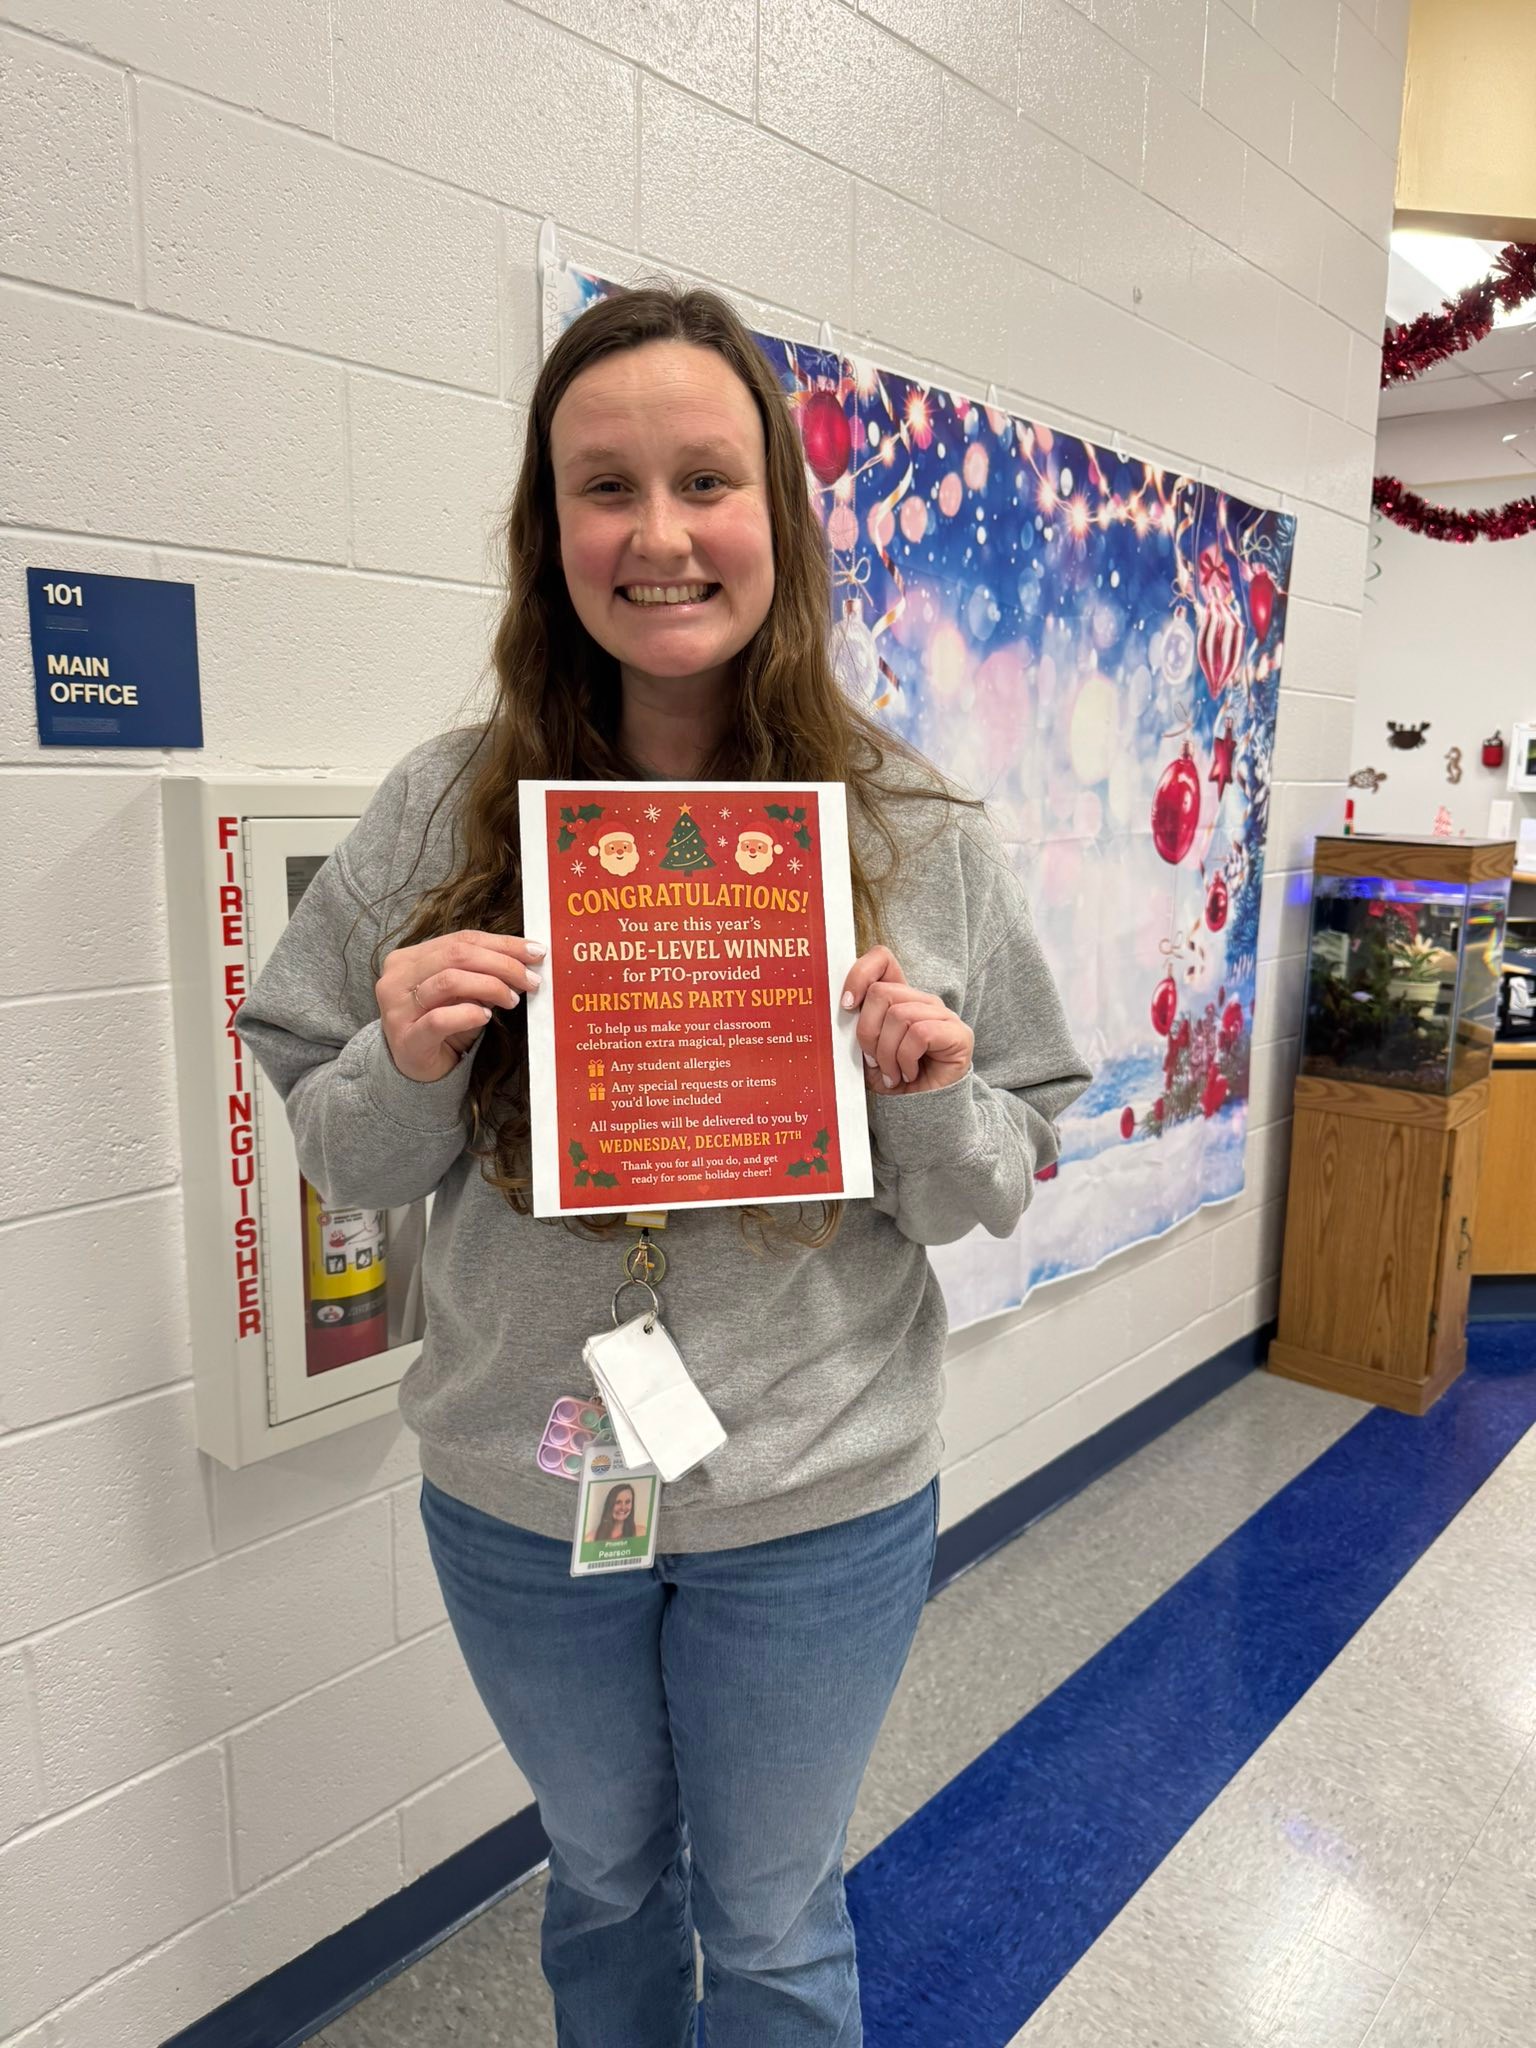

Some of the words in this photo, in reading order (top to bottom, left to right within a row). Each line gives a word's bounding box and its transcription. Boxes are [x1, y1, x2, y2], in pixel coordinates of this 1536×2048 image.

[43, 583, 83, 606] 101
[47, 654, 110, 677] MAIN
[49, 682, 139, 705] OFFICE
[218, 816, 244, 946] FIRE
[568, 883, 808, 915] CONGRATULATIONS!
[618, 918, 648, 932] You
[654, 921, 678, 932] are
[684, 917, 712, 931] this
[716, 917, 761, 934] year’s
[573, 940, 720, 961] GRADE-LEVEL
[724, 938, 810, 958] WINNER
[623, 968, 645, 982] for
[650, 966, 760, 984] PTO-provided
[572, 991, 683, 1012] CHRISTMAS
[688, 990, 746, 1009] PARTY
[752, 988, 812, 1006] SUPPL!
[587, 1024, 602, 1034] To
[605, 1023, 629, 1036] help
[634, 1024, 647, 1032] us
[651, 1022, 681, 1032] make
[685, 1023, 710, 1034] your
[714, 1019, 771, 1031] classroom
[576, 1039, 642, 1051] celebration
[645, 1039, 675, 1048] extra
[678, 1036, 726, 1049] magical,
[729, 1035, 763, 1048] please
[767, 1034, 792, 1044] send
[797, 1034, 812, 1042] us:
[611, 1061, 634, 1073] Any
[638, 1060, 680, 1071] student
[683, 1058, 731, 1070] allergies
[611, 1083, 634, 1095] Any
[639, 1080, 677, 1093] special
[681, 1080, 728, 1092] requests
[731, 1079, 743, 1088] or
[746, 1077, 776, 1087] items
[611, 1097, 642, 1111] you’d
[646, 1097, 669, 1107] love
[673, 1094, 721, 1106] included
[590, 1121, 607, 1132] All
[610, 1121, 657, 1133] supplies
[662, 1119, 682, 1129] will
[686, 1118, 699, 1128] be
[702, 1115, 753, 1127] delivered
[757, 1116, 768, 1125] to
[771, 1115, 791, 1125] you
[795, 1112, 808, 1124] by
[224, 964, 262, 1338] EXTINGUISHER
[600, 1136, 691, 1153] WEDNESDAY,
[695, 1132, 770, 1149] DECEMBER
[622, 1161, 652, 1171] Thank
[655, 1161, 672, 1170] you
[675, 1159, 688, 1168] for
[692, 1157, 703, 1167] all
[706, 1159, 723, 1167] you
[727, 1157, 741, 1166] do,
[744, 1155, 760, 1164] and
[764, 1155, 778, 1164] get
[631, 1174, 658, 1184] ready
[661, 1173, 674, 1182] for
[677, 1173, 702, 1181] some
[705, 1169, 739, 1180] holiday
[743, 1168, 772, 1177] cheer!
[598, 1549, 631, 1559] Pearson
